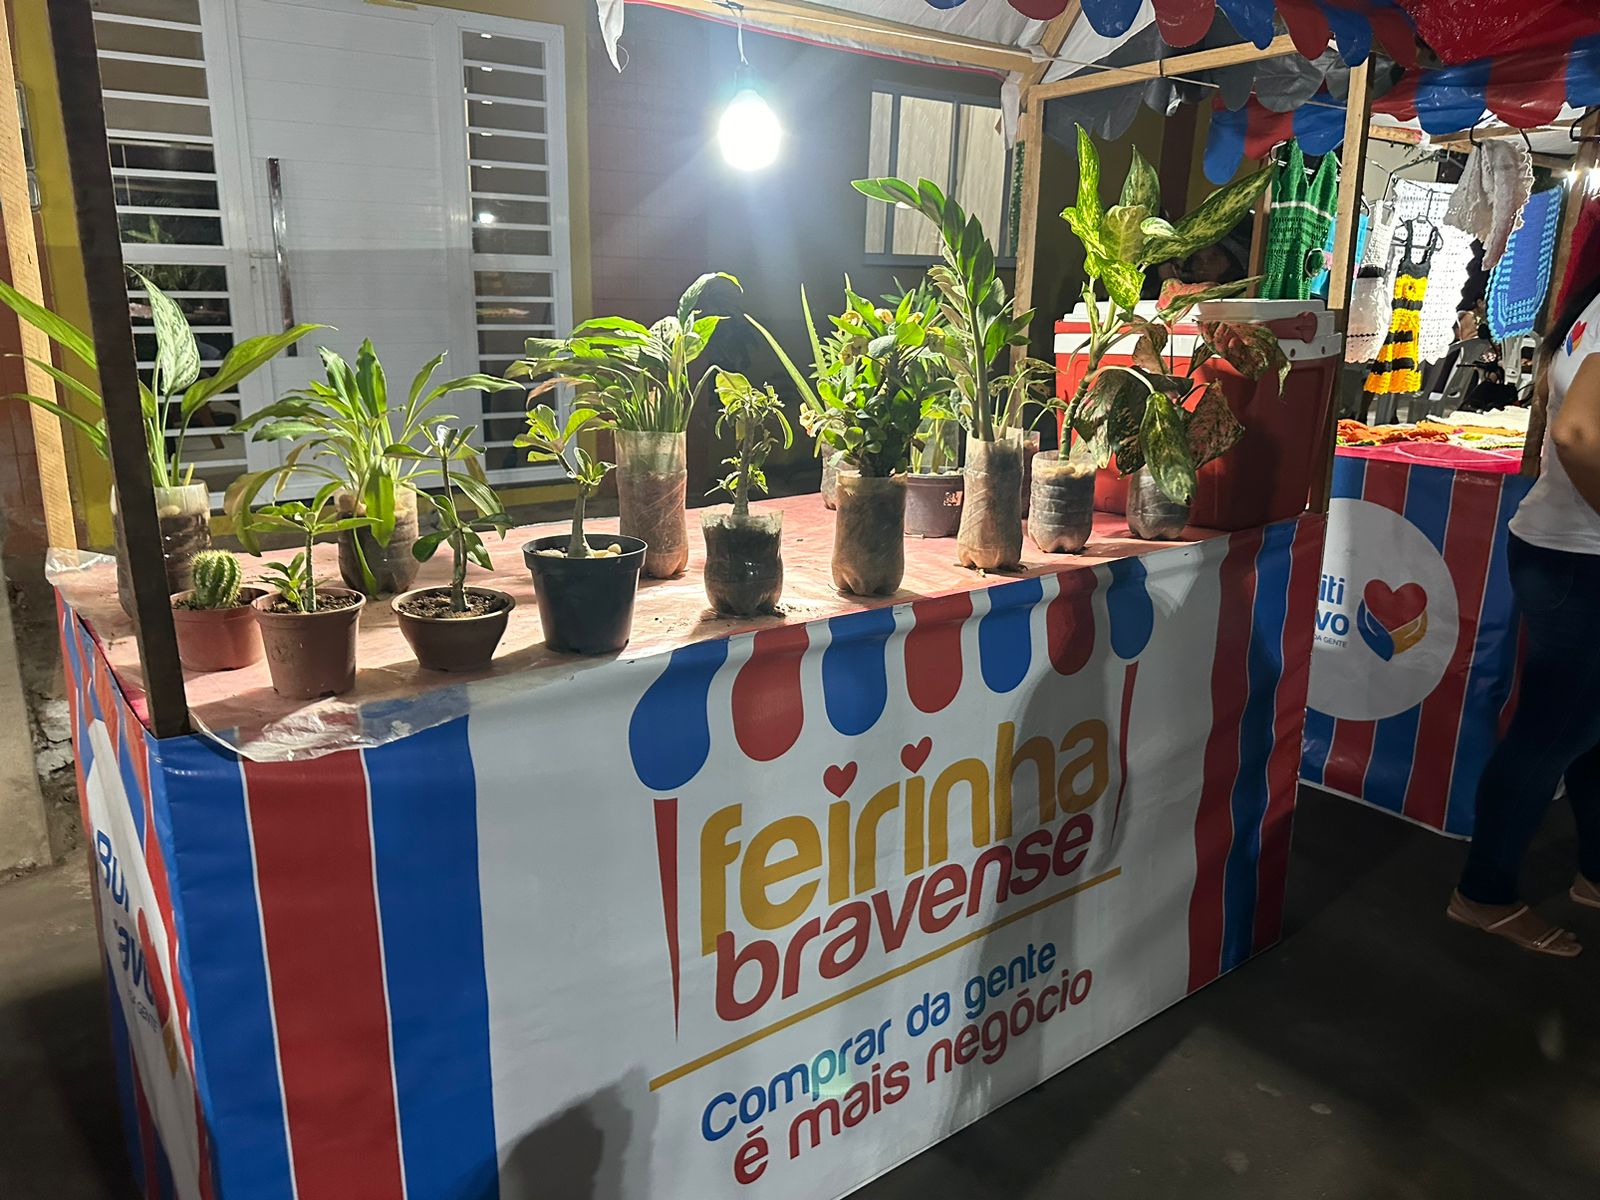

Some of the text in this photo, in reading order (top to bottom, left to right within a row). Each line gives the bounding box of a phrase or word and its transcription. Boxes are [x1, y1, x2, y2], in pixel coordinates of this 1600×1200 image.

[1324, 636, 1347, 648] GENTE
[700, 719, 1109, 956] feirinha
[715, 813, 1093, 1021] bravense
[701, 942, 1056, 1142] Comprar da gente
[733, 969, 1093, 1185] é mais negócio
